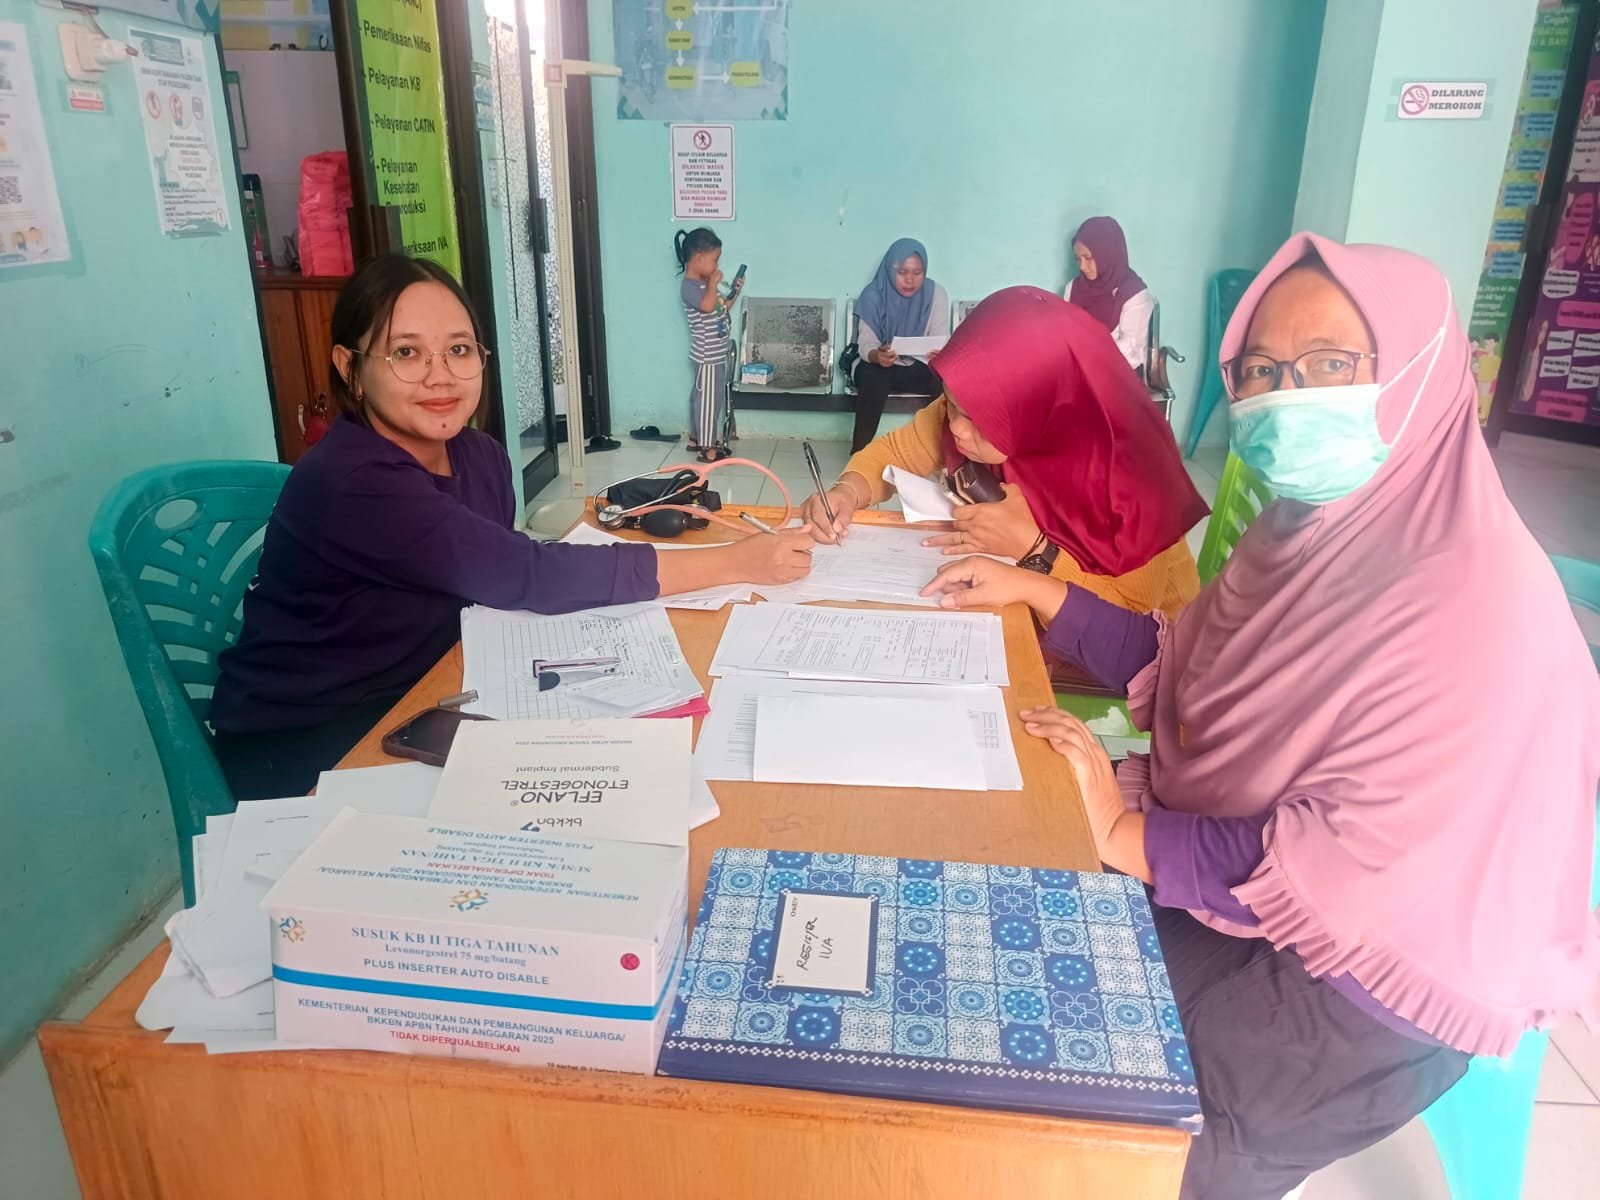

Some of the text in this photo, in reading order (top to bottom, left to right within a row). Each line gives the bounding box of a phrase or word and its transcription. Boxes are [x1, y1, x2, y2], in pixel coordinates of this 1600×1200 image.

[363, 19, 431, 53] Pemeriksaan Nifas
[368, 67, 420, 91] Pelayanan KB
[1431, 89, 1484, 97] DILARANG
[1428, 102, 1482, 110] MEROKOK
[375, 114, 435, 134] Pelayanan CATIN
[381, 158, 417, 176] Pelayanan
[383, 180, 420, 195] Kesehatan
[516, 765, 620, 773] Subdermal Implant
[501, 779, 629, 790] ETONOGESTREL
[537, 817, 583, 827] bkkbn
[426, 826, 594, 850] PLUS INSERTER AUTO DISABLE
[376, 871, 454, 885] PEMBANGUNAN
[414, 868, 472, 879] ANGGARAN
[427, 861, 555, 879] TIDAK DIPERJUALBELIKAN
[471, 873, 505, 883] TAHUN
[455, 878, 477, 887] DAN
[566, 888, 639, 902] KEMENTERIAN
[351, 926, 560, 956] SUSUK KB II TIGA TAHUNAN
[819, 937, 835, 959] IVA
[460, 950, 472, 960] 75
[364, 958, 550, 985] PLUS INSERTER AUTO DISABLE
[298, 997, 626, 1042] KEMENTERIAN KEPENDUDUKAN DAN PEMBANGUNAN KELUARGA/
[367, 1015, 555, 1045] BKKBN APBN TAHUN ANGGARAN 2025
[390, 1030, 521, 1053] TIDAK DIPERJUALBELIKAN
